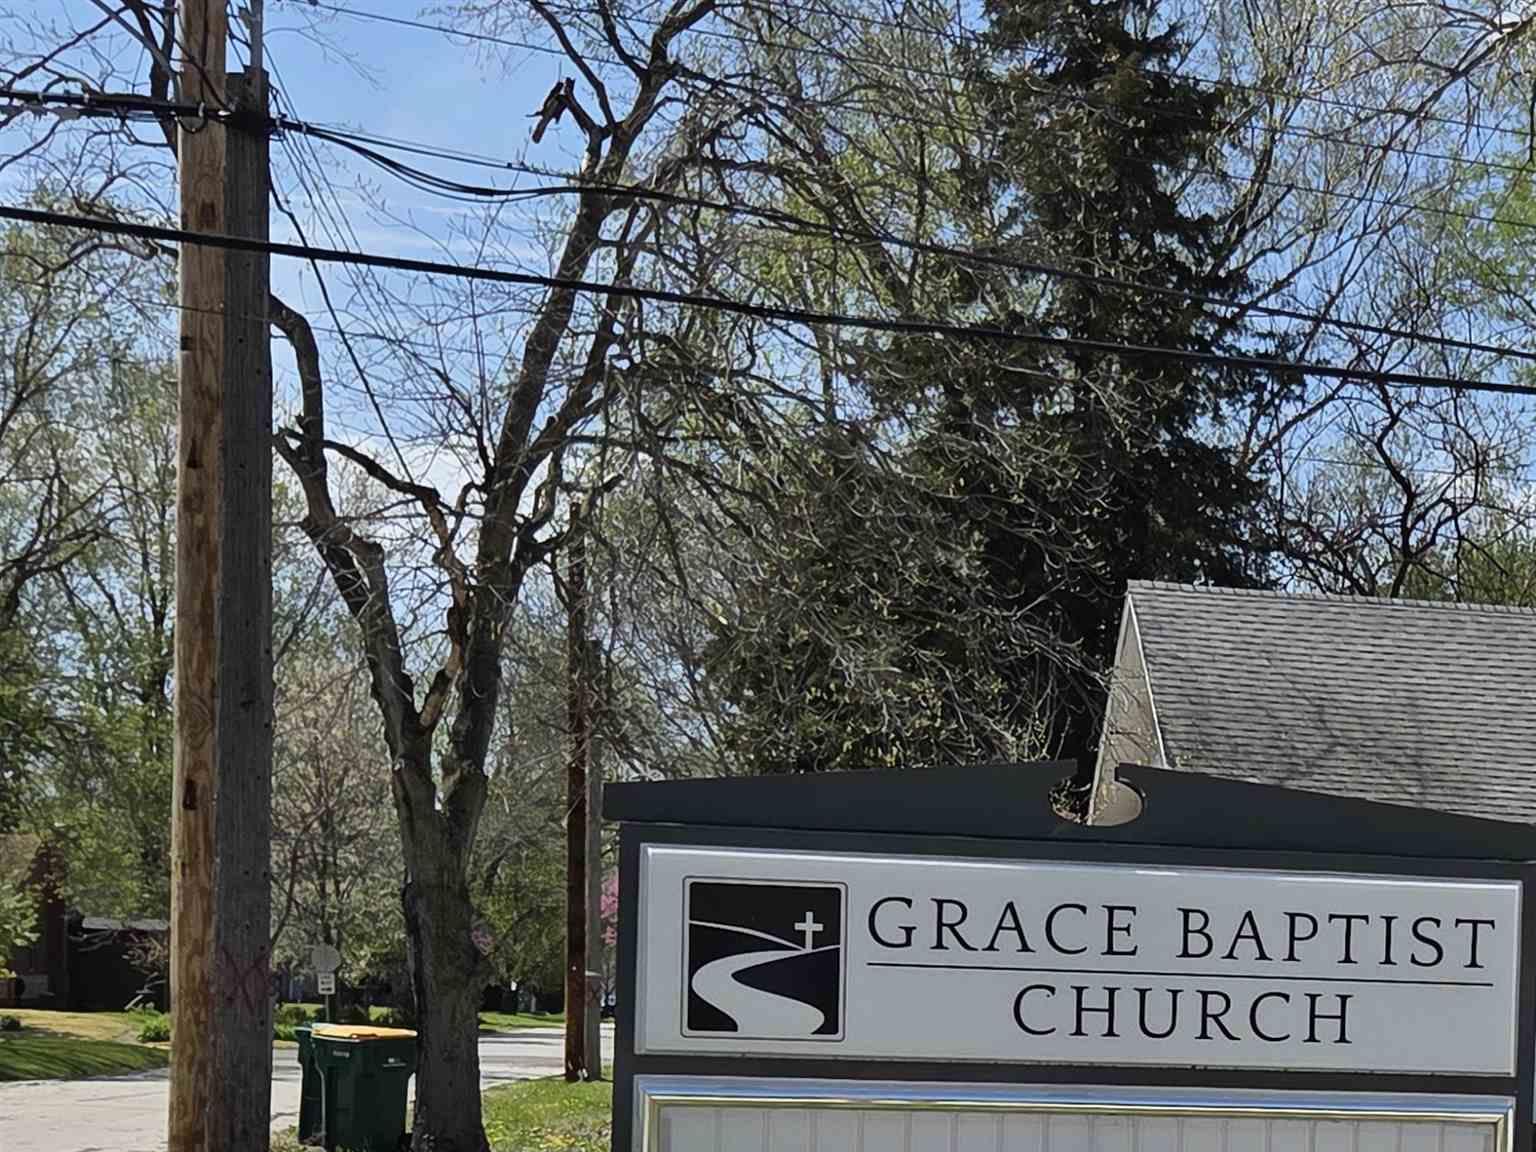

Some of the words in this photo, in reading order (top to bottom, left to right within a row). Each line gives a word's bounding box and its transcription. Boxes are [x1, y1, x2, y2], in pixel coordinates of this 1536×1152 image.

[866, 896, 1139, 958] GRACE
[1175, 907, 1497, 970] BAPTIST
[1012, 983, 1355, 1045] CHURCH
